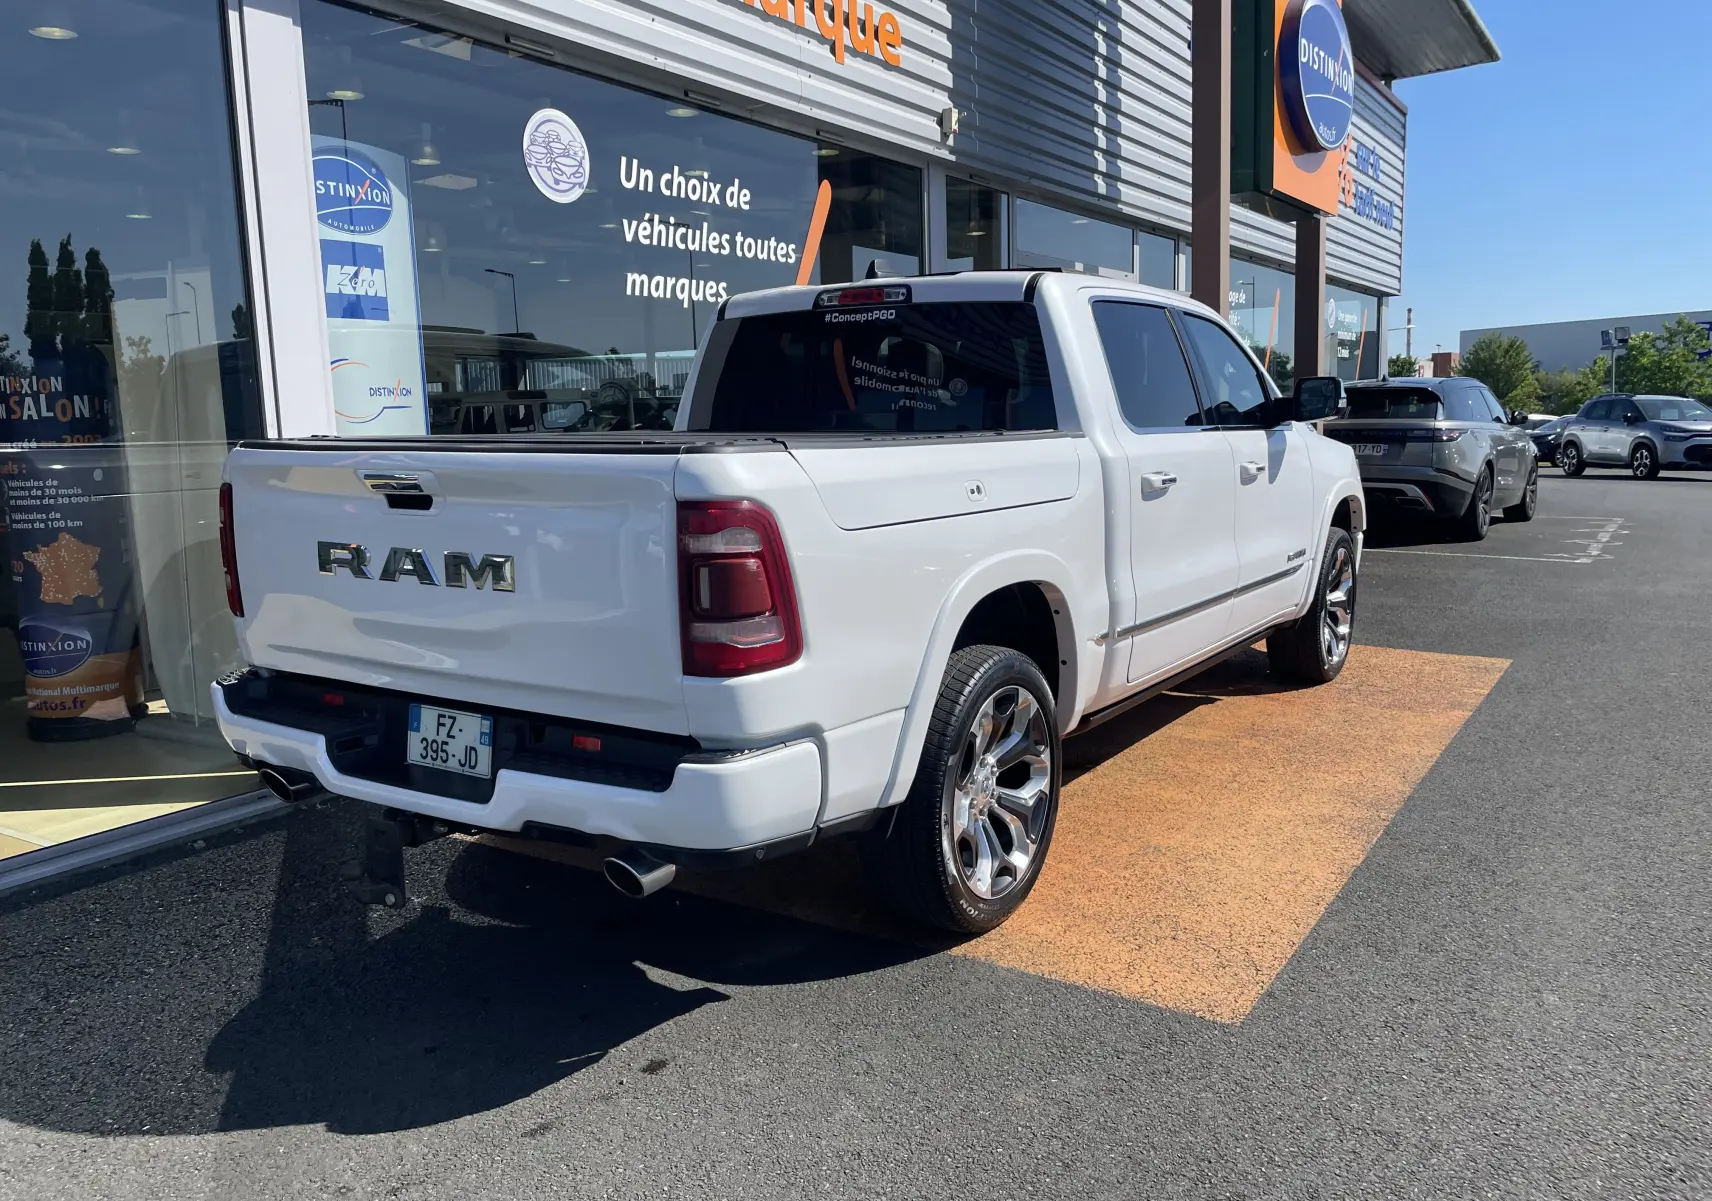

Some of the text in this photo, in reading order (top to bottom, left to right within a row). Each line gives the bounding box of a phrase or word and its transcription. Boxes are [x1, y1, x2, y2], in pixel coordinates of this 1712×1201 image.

[1301, 38, 1352, 96] DISTINXION
[1318, 121, 1337, 142] autos.fr
[619, 156, 751, 211] Un choix de
[327, 218, 375, 232] AUTOMOBILE
[622, 213, 796, 264] véhicules toutes
[625, 272, 728, 308] marques
[824, 309, 896, 323] #ConceptPGO
[369, 382, 412, 400] DISTINXION
[9, 394, 90, 423] SALON
[8, 479, 44, 488] Véhicules
[8, 487, 82, 497] moins de 30 mois
[16, 498, 41, 506] moins
[42, 497, 55, 505] de
[57, 496, 69, 504] 30
[71, 495, 90, 503] 000
[11, 511, 61, 521] Véhicules de
[12, 519, 83, 529] moins de 100 km
[317, 540, 516, 593] RAM
[62, 681, 120, 696] Multimarque
[480, 735, 489, 745] 49
